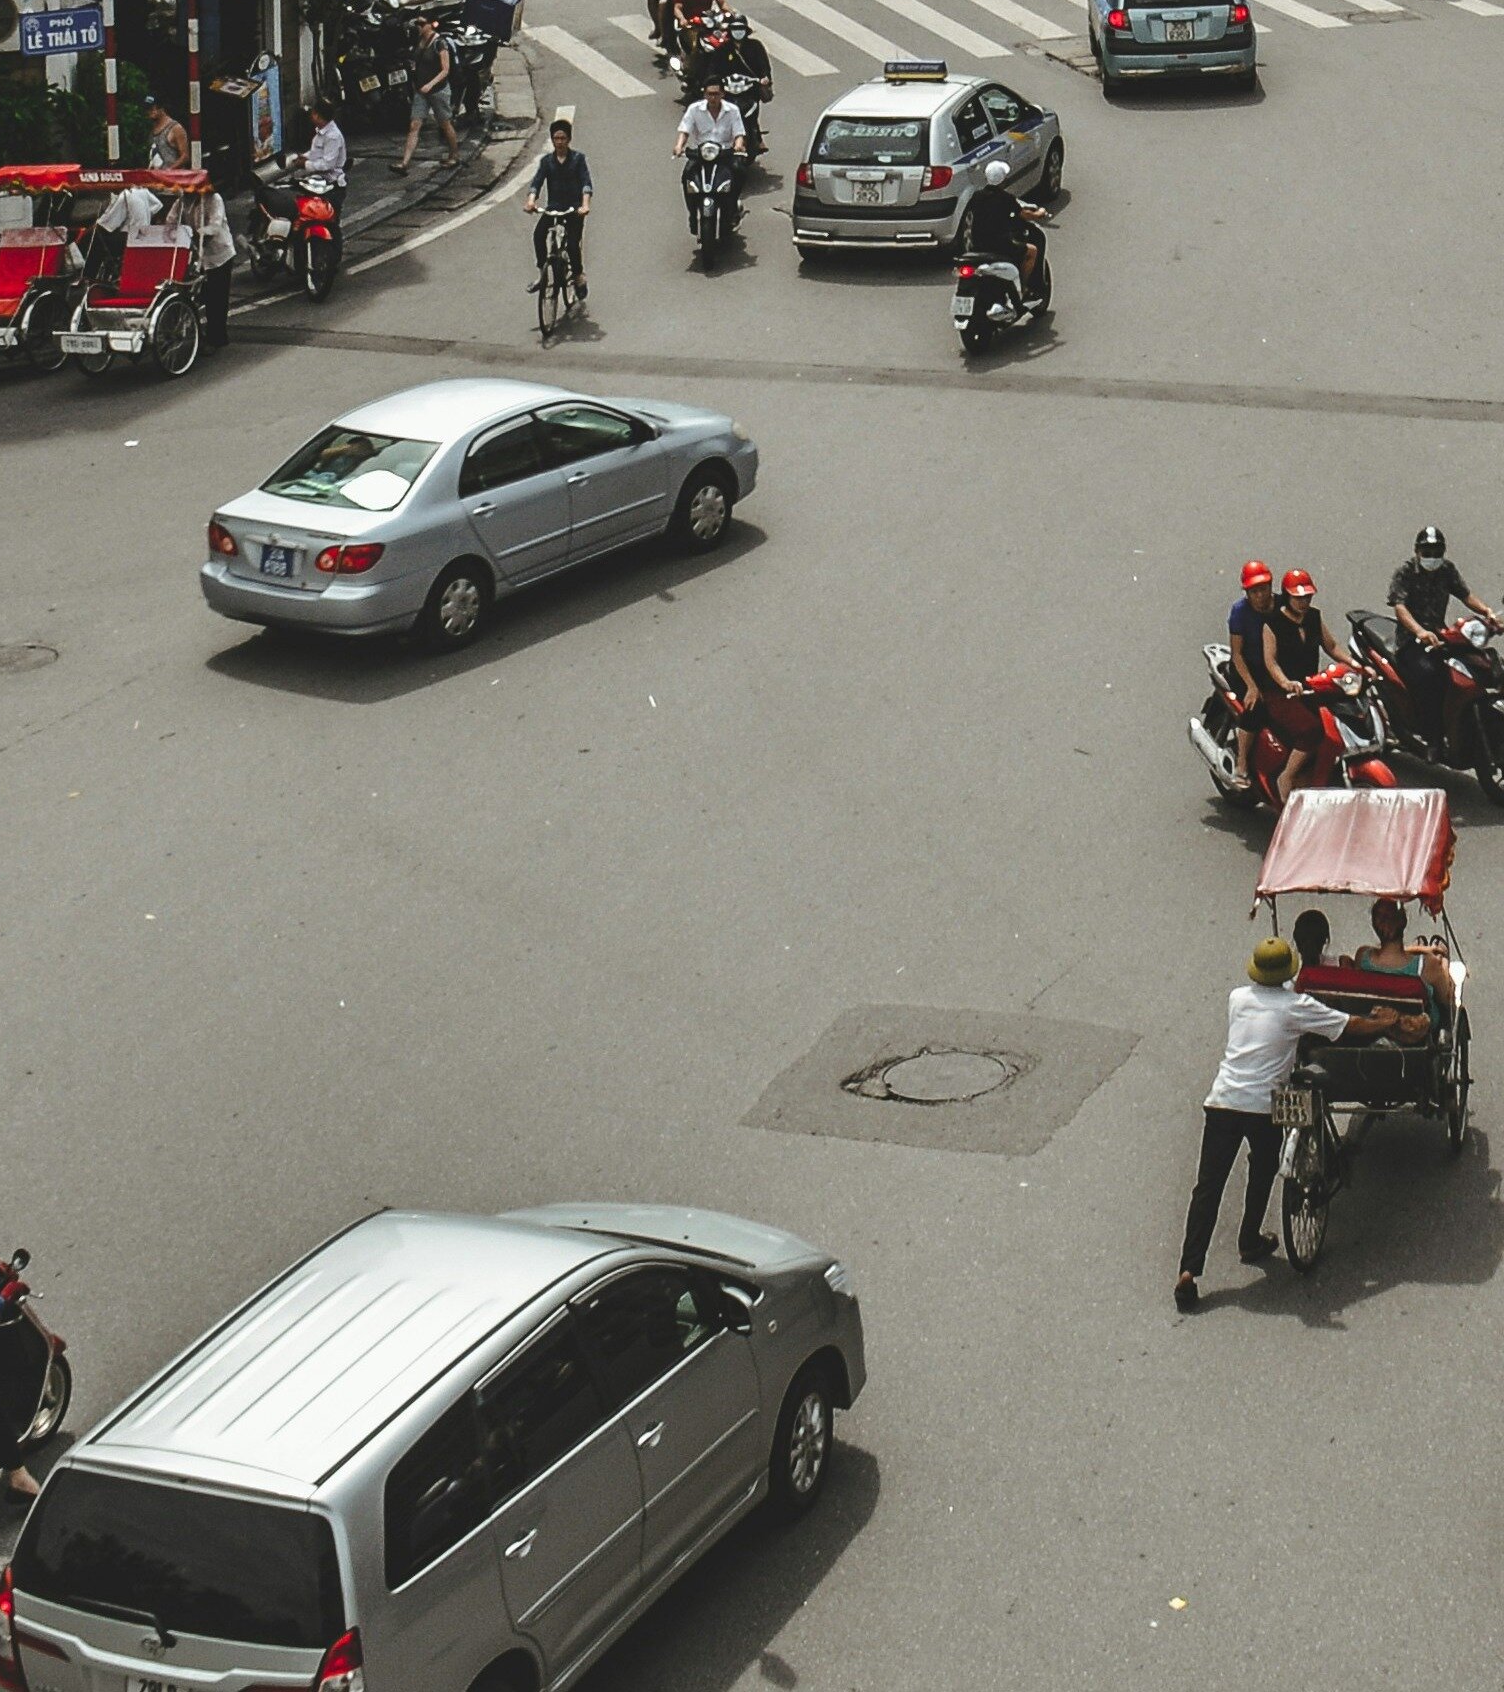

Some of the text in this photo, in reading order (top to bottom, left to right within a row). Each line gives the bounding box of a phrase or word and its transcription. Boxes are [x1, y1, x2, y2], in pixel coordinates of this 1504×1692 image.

[48, 15, 73, 28] PHỐ
[27, 31, 44, 50] LÊ
[46, 27, 77, 46] THÁI
